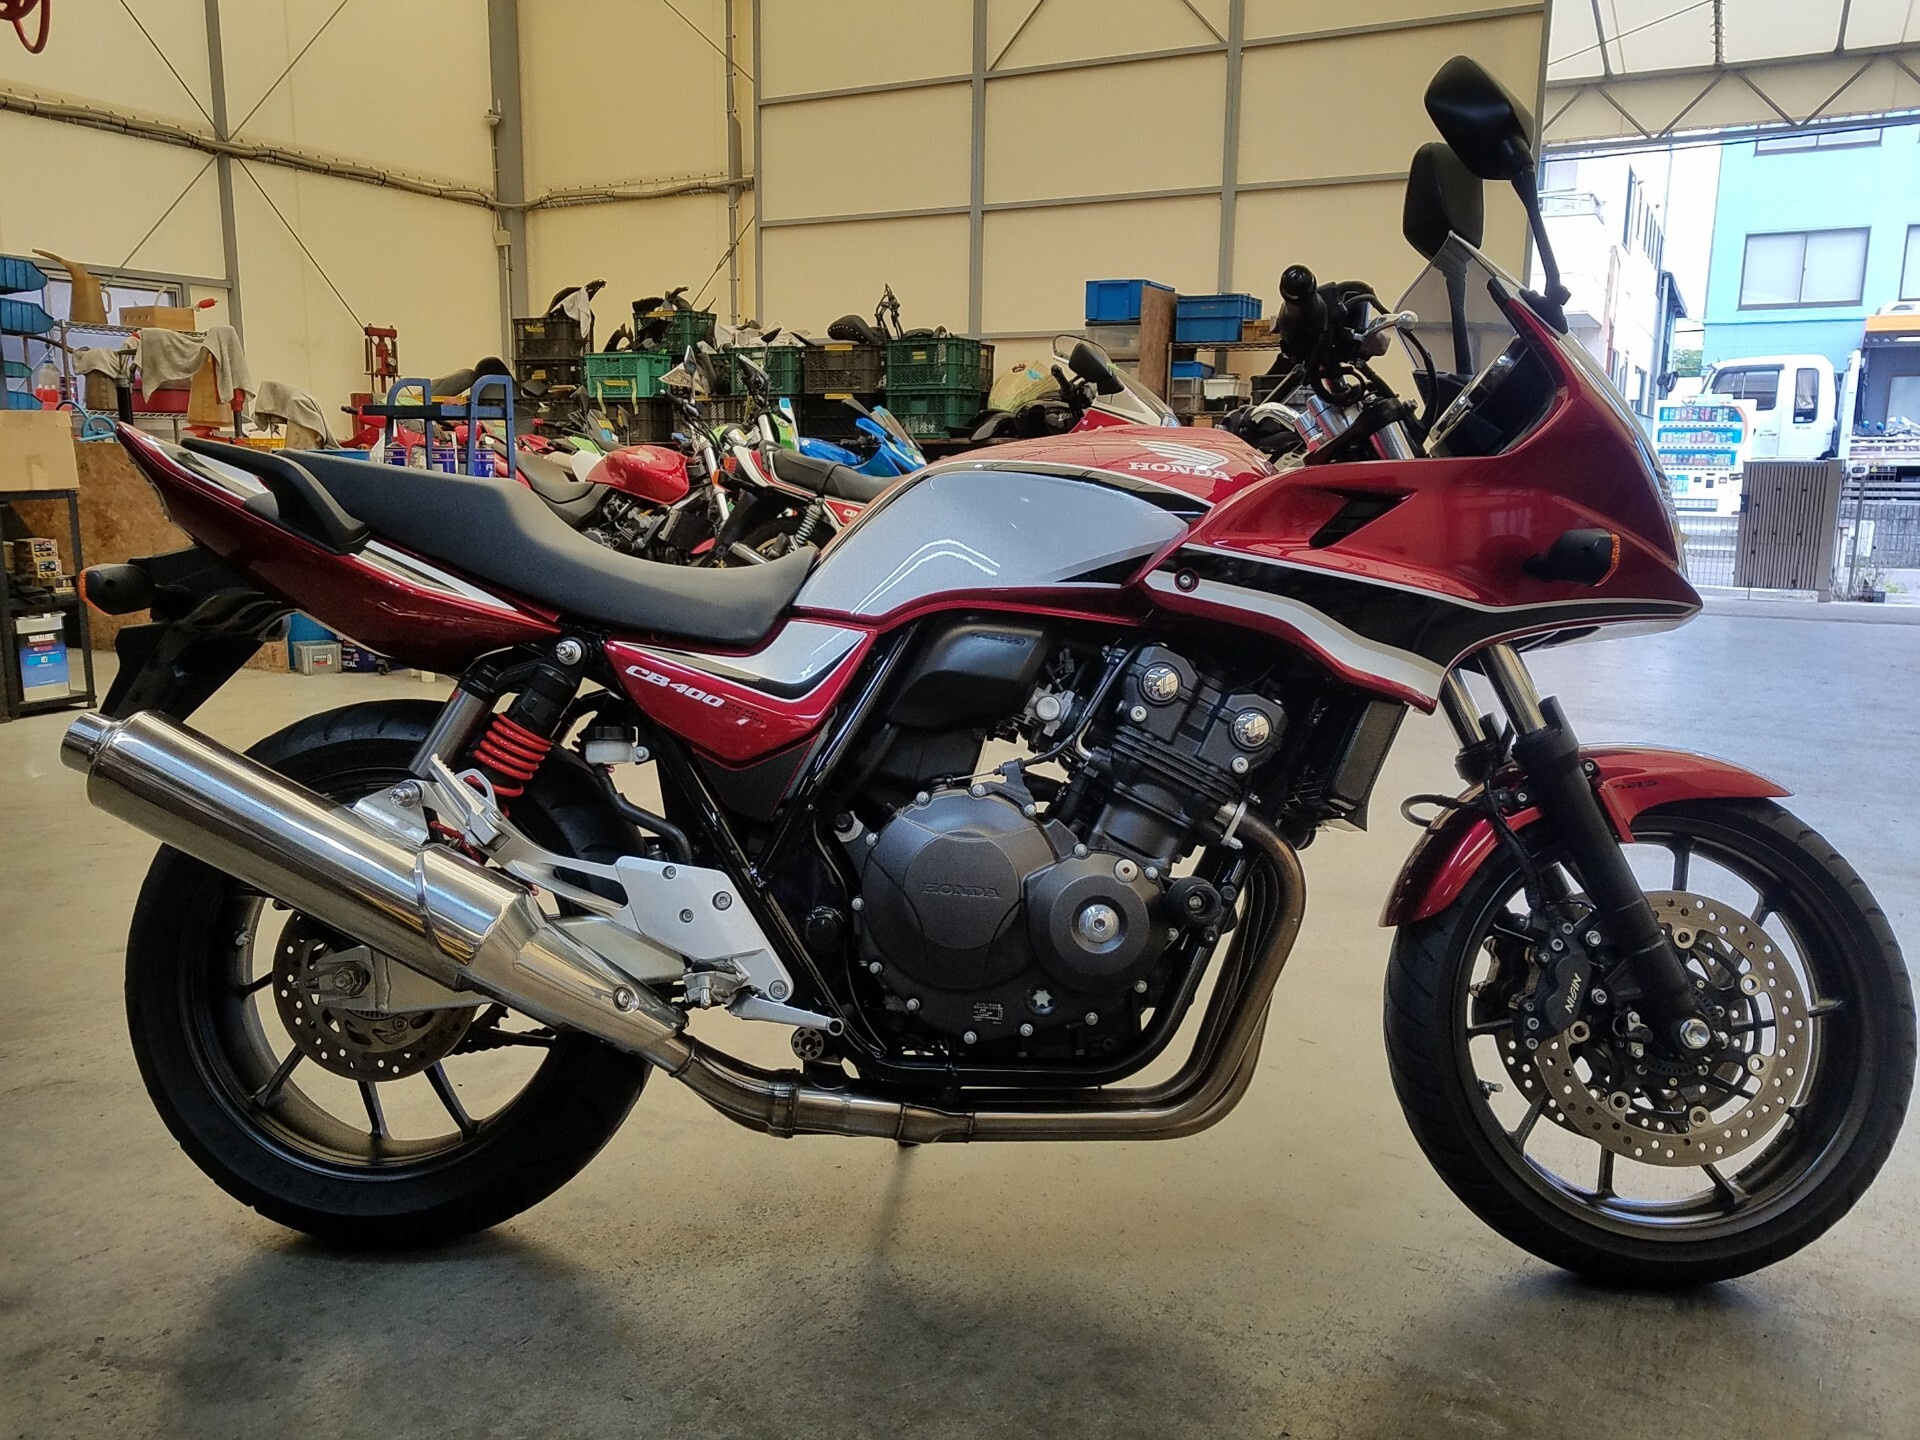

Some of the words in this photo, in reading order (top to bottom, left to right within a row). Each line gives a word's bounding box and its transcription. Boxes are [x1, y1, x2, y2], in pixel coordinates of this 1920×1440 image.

[1128, 462, 1233, 482] HONDA
[625, 665, 725, 708] CB400
[921, 881, 1001, 899] HONDA
